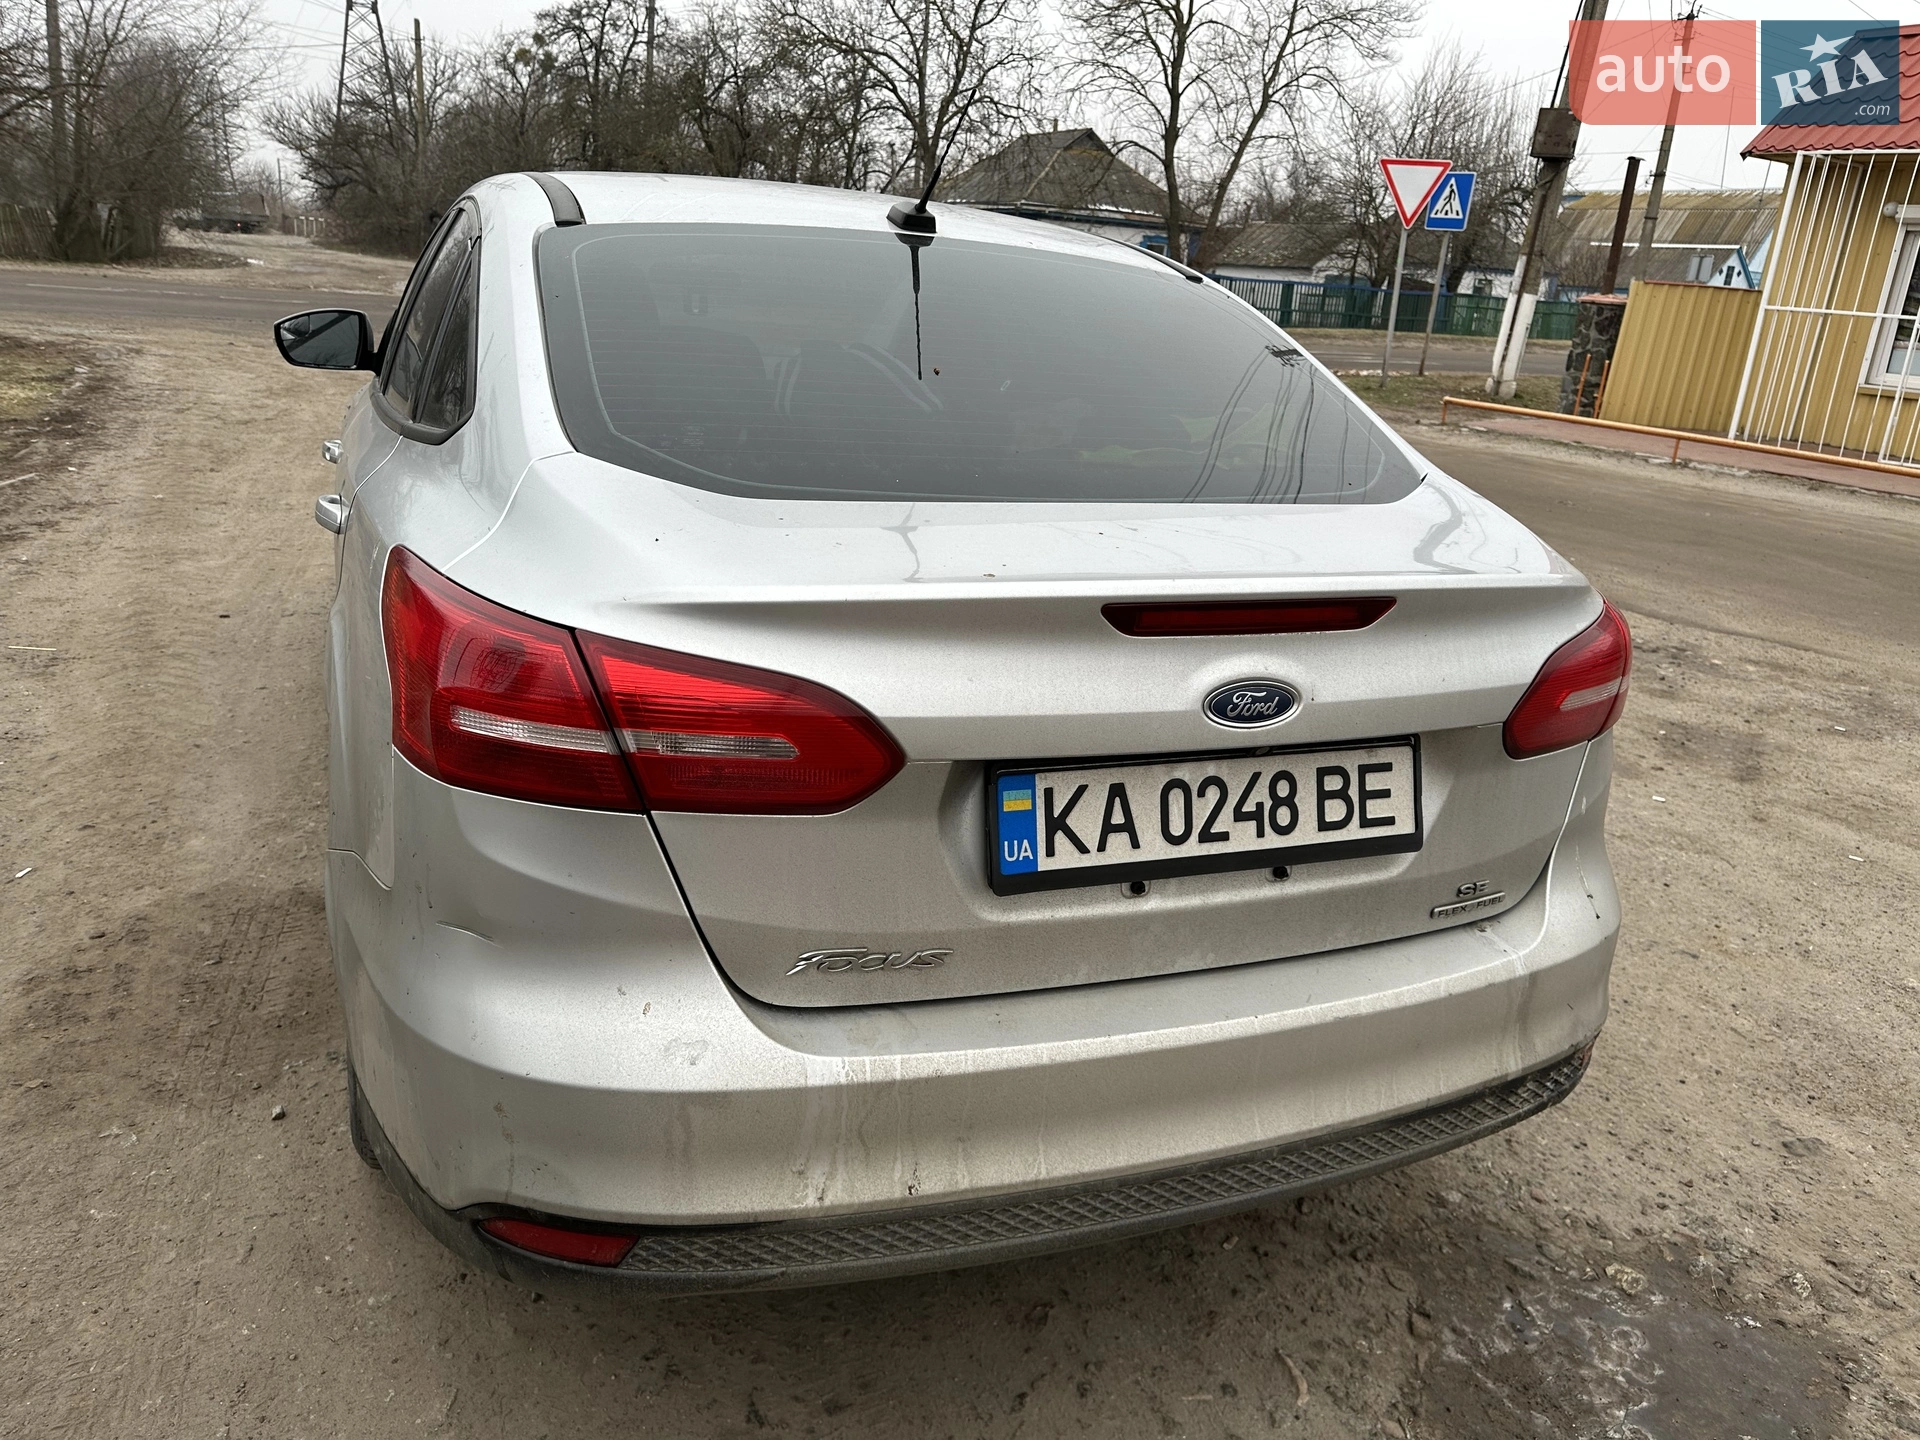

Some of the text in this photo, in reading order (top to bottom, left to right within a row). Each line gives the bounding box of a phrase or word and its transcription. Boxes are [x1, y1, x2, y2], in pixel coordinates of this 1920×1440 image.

[1226, 691, 1280, 718] Ford
[1043, 762, 1396, 858] KA 0248 BE
[1003, 839, 1034, 863] UA
[1456, 880, 1490, 898] SE
[1437, 896, 1504, 918] FLEX FUEL
